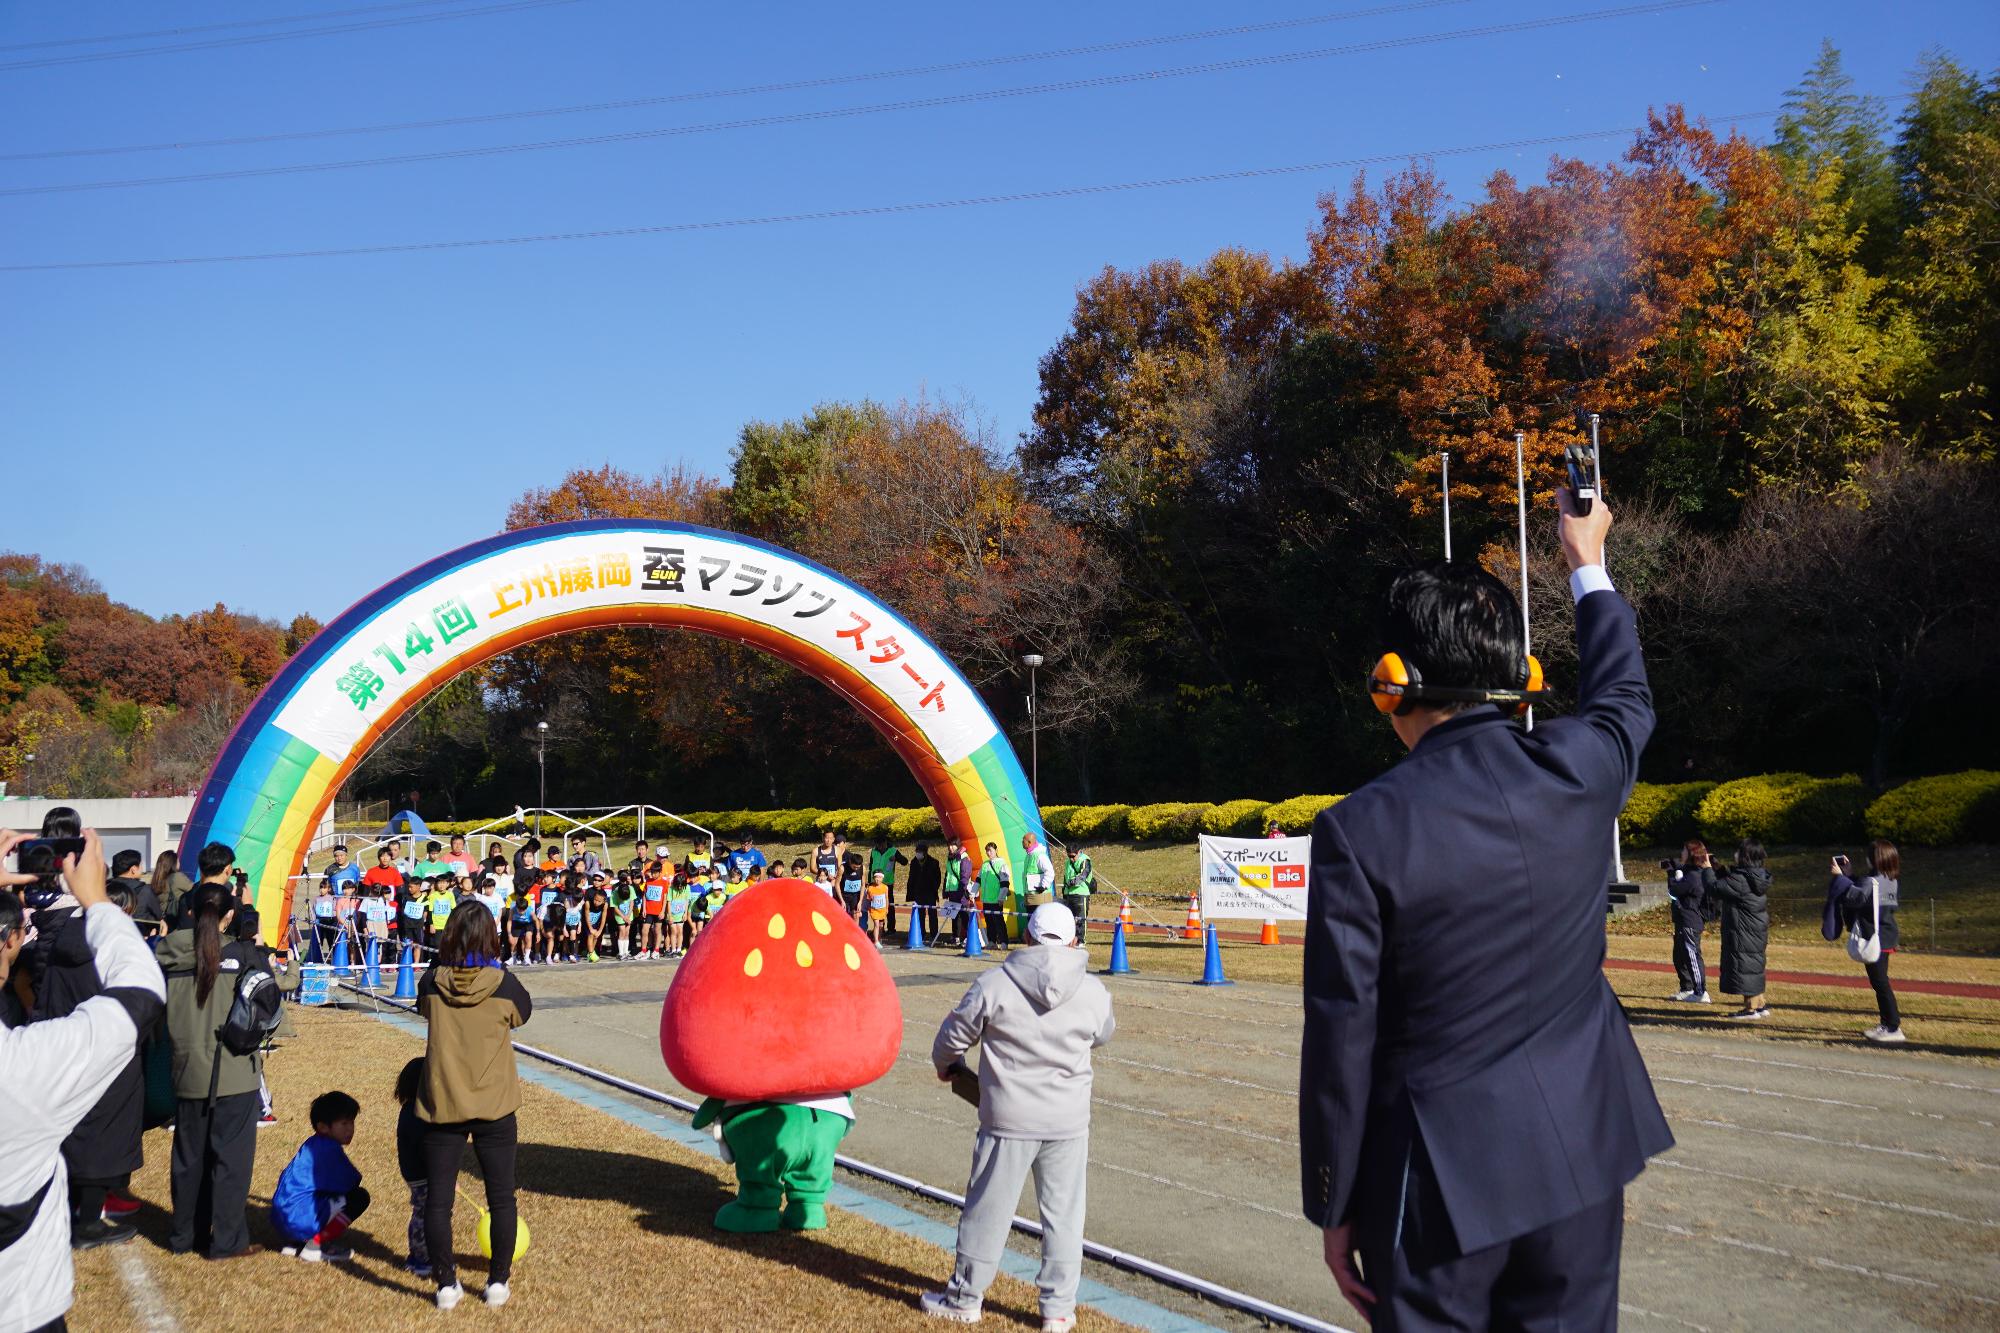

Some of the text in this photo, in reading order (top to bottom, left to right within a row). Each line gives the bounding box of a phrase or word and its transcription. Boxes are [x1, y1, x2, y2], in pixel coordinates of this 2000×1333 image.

[650, 569, 679, 581] SUN
[336, 594, 478, 711] 第14回
[488, 551, 632, 619] 上州藤岡
[836, 610, 946, 712] スタート
[1222, 848, 1289, 862] スポーツくじ
